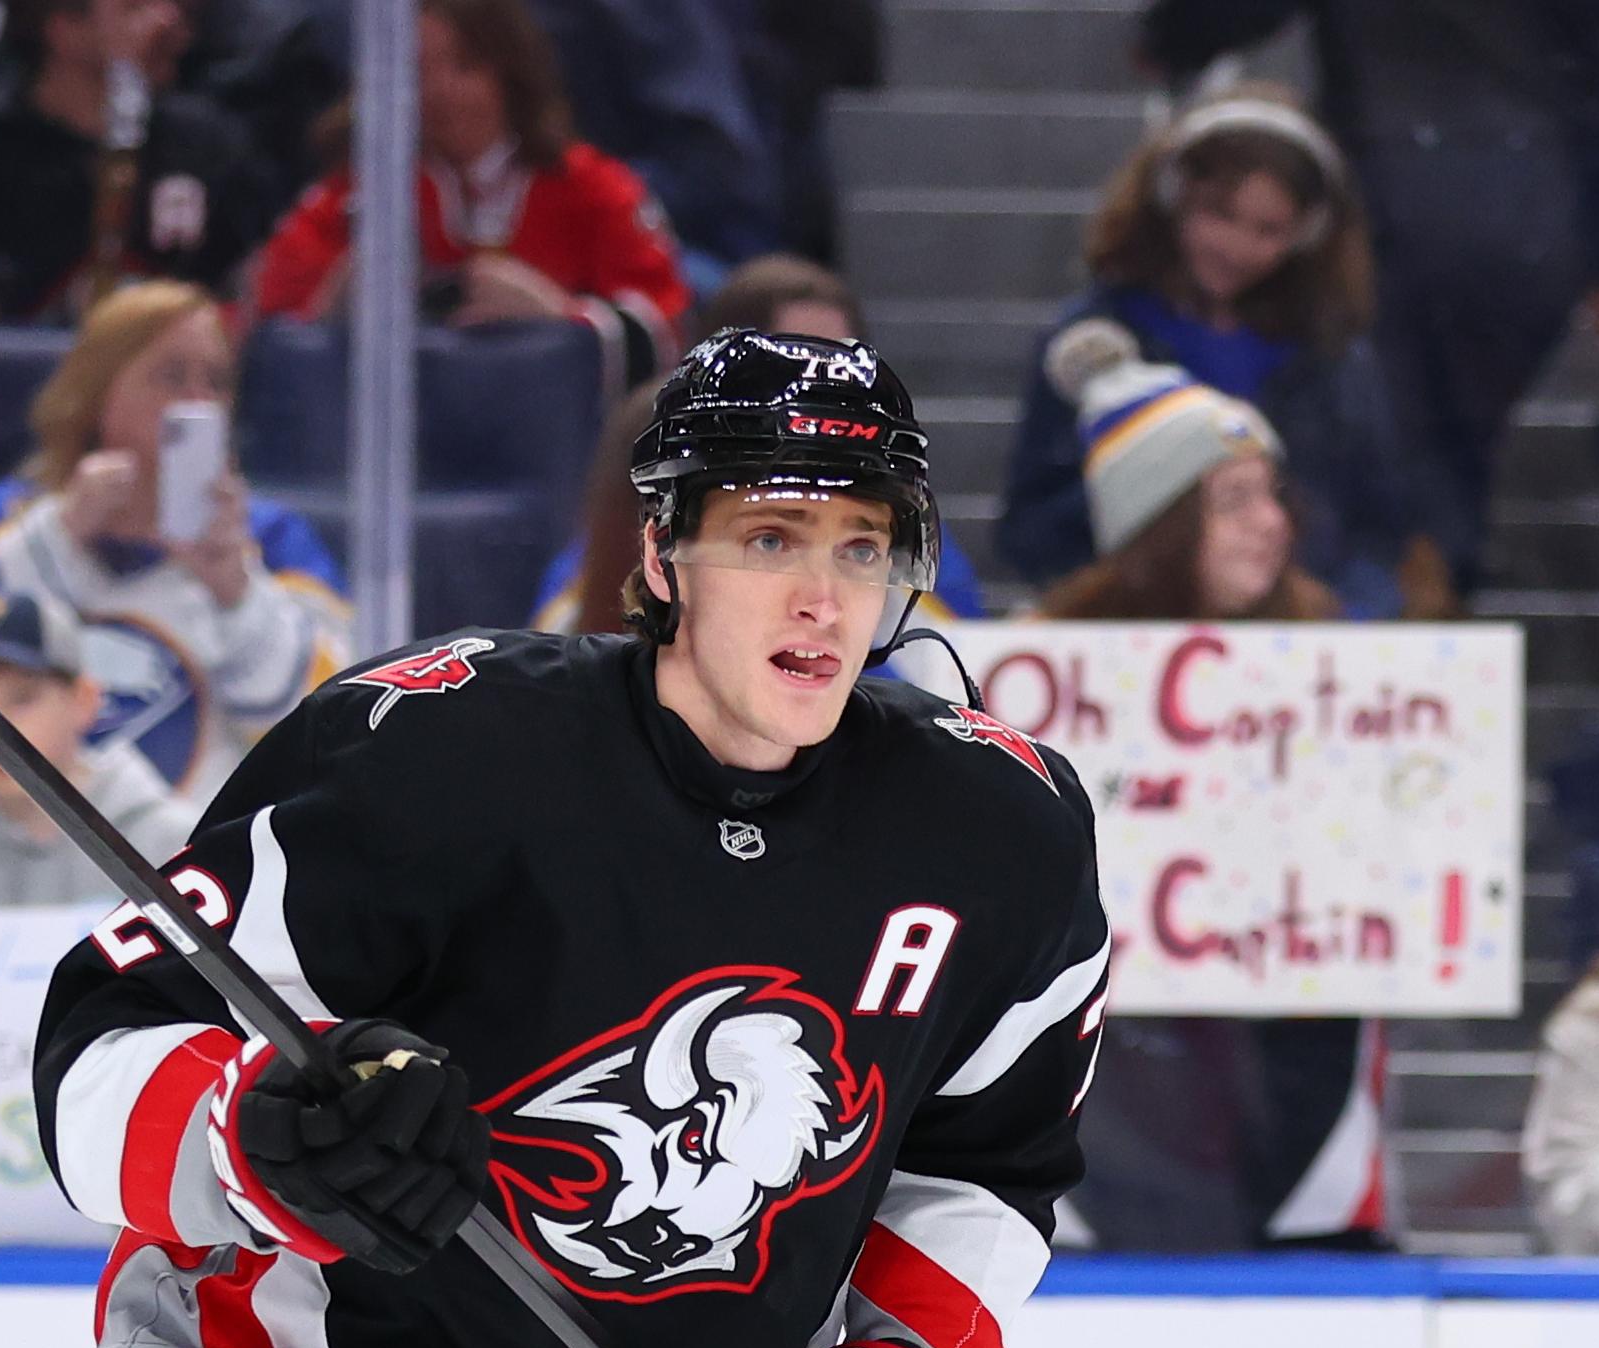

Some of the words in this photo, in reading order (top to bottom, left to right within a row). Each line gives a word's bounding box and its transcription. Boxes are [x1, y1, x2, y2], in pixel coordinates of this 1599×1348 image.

[788, 416, 879, 440] CCM
[981, 652, 1112, 742] Oh
[1156, 634, 1449, 778] Captain
[730, 831, 755, 848] NHL
[852, 903, 963, 1017] A
[1150, 858, 1399, 988] Captain
